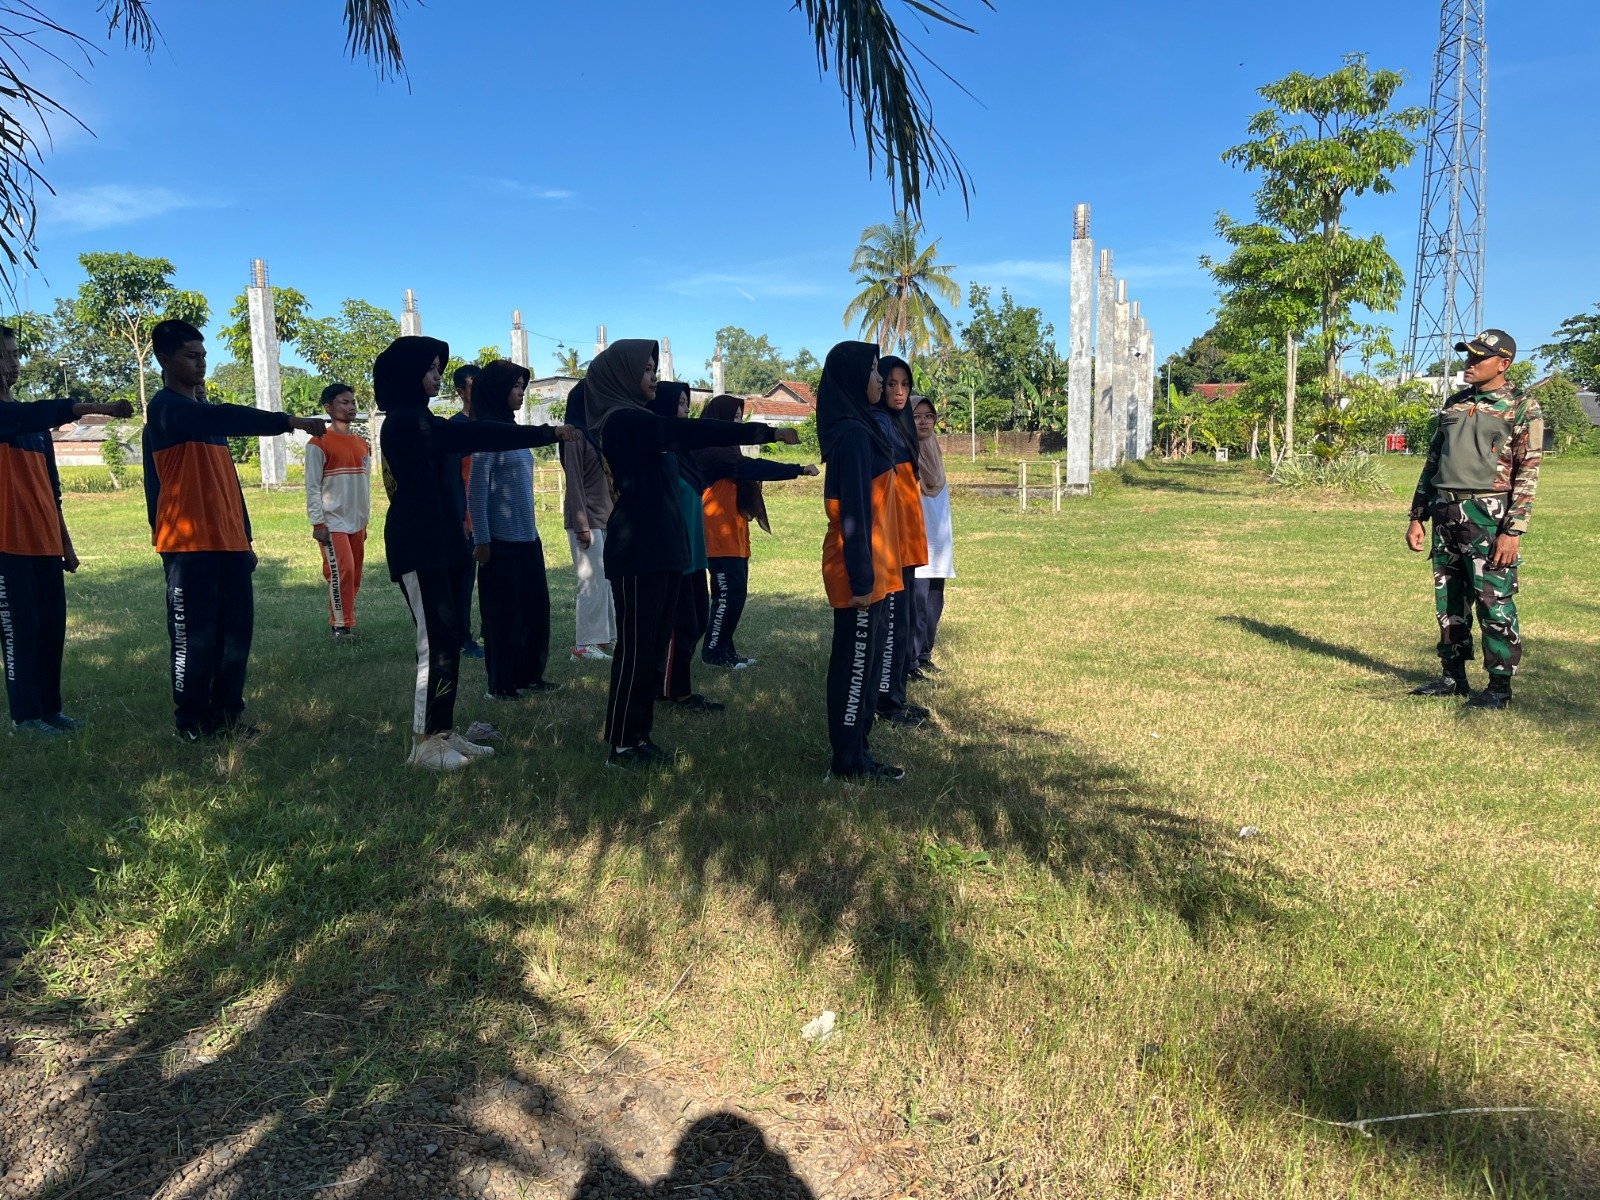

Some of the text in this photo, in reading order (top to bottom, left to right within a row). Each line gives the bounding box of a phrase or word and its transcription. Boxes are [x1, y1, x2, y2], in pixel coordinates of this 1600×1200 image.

[331, 564, 342, 611] BANYUWANGI
[717, 572, 728, 591] MAN
[0, 610, 15, 681] BANYUWANGI
[174, 587, 187, 692] MAN 3 BANYUWANGI
[843, 607, 869, 727] AN 3 BANYUWANGI
